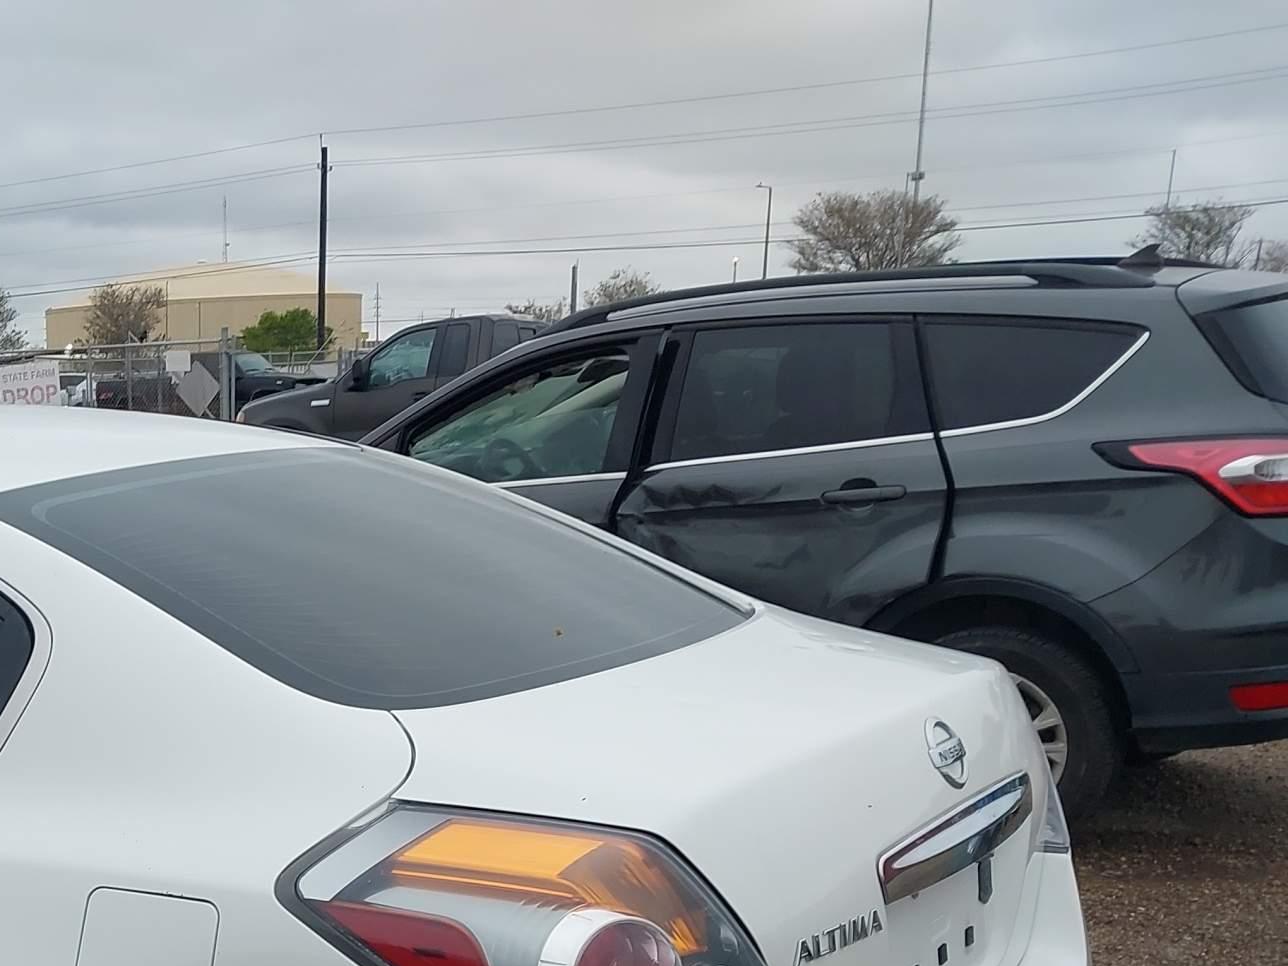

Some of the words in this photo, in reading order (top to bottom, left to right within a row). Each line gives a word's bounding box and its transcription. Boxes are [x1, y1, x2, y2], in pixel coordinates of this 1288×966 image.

[2, 371, 28, 383] STATE
[31, 368, 56, 379] FARM
[2, 384, 58, 404] DROP
